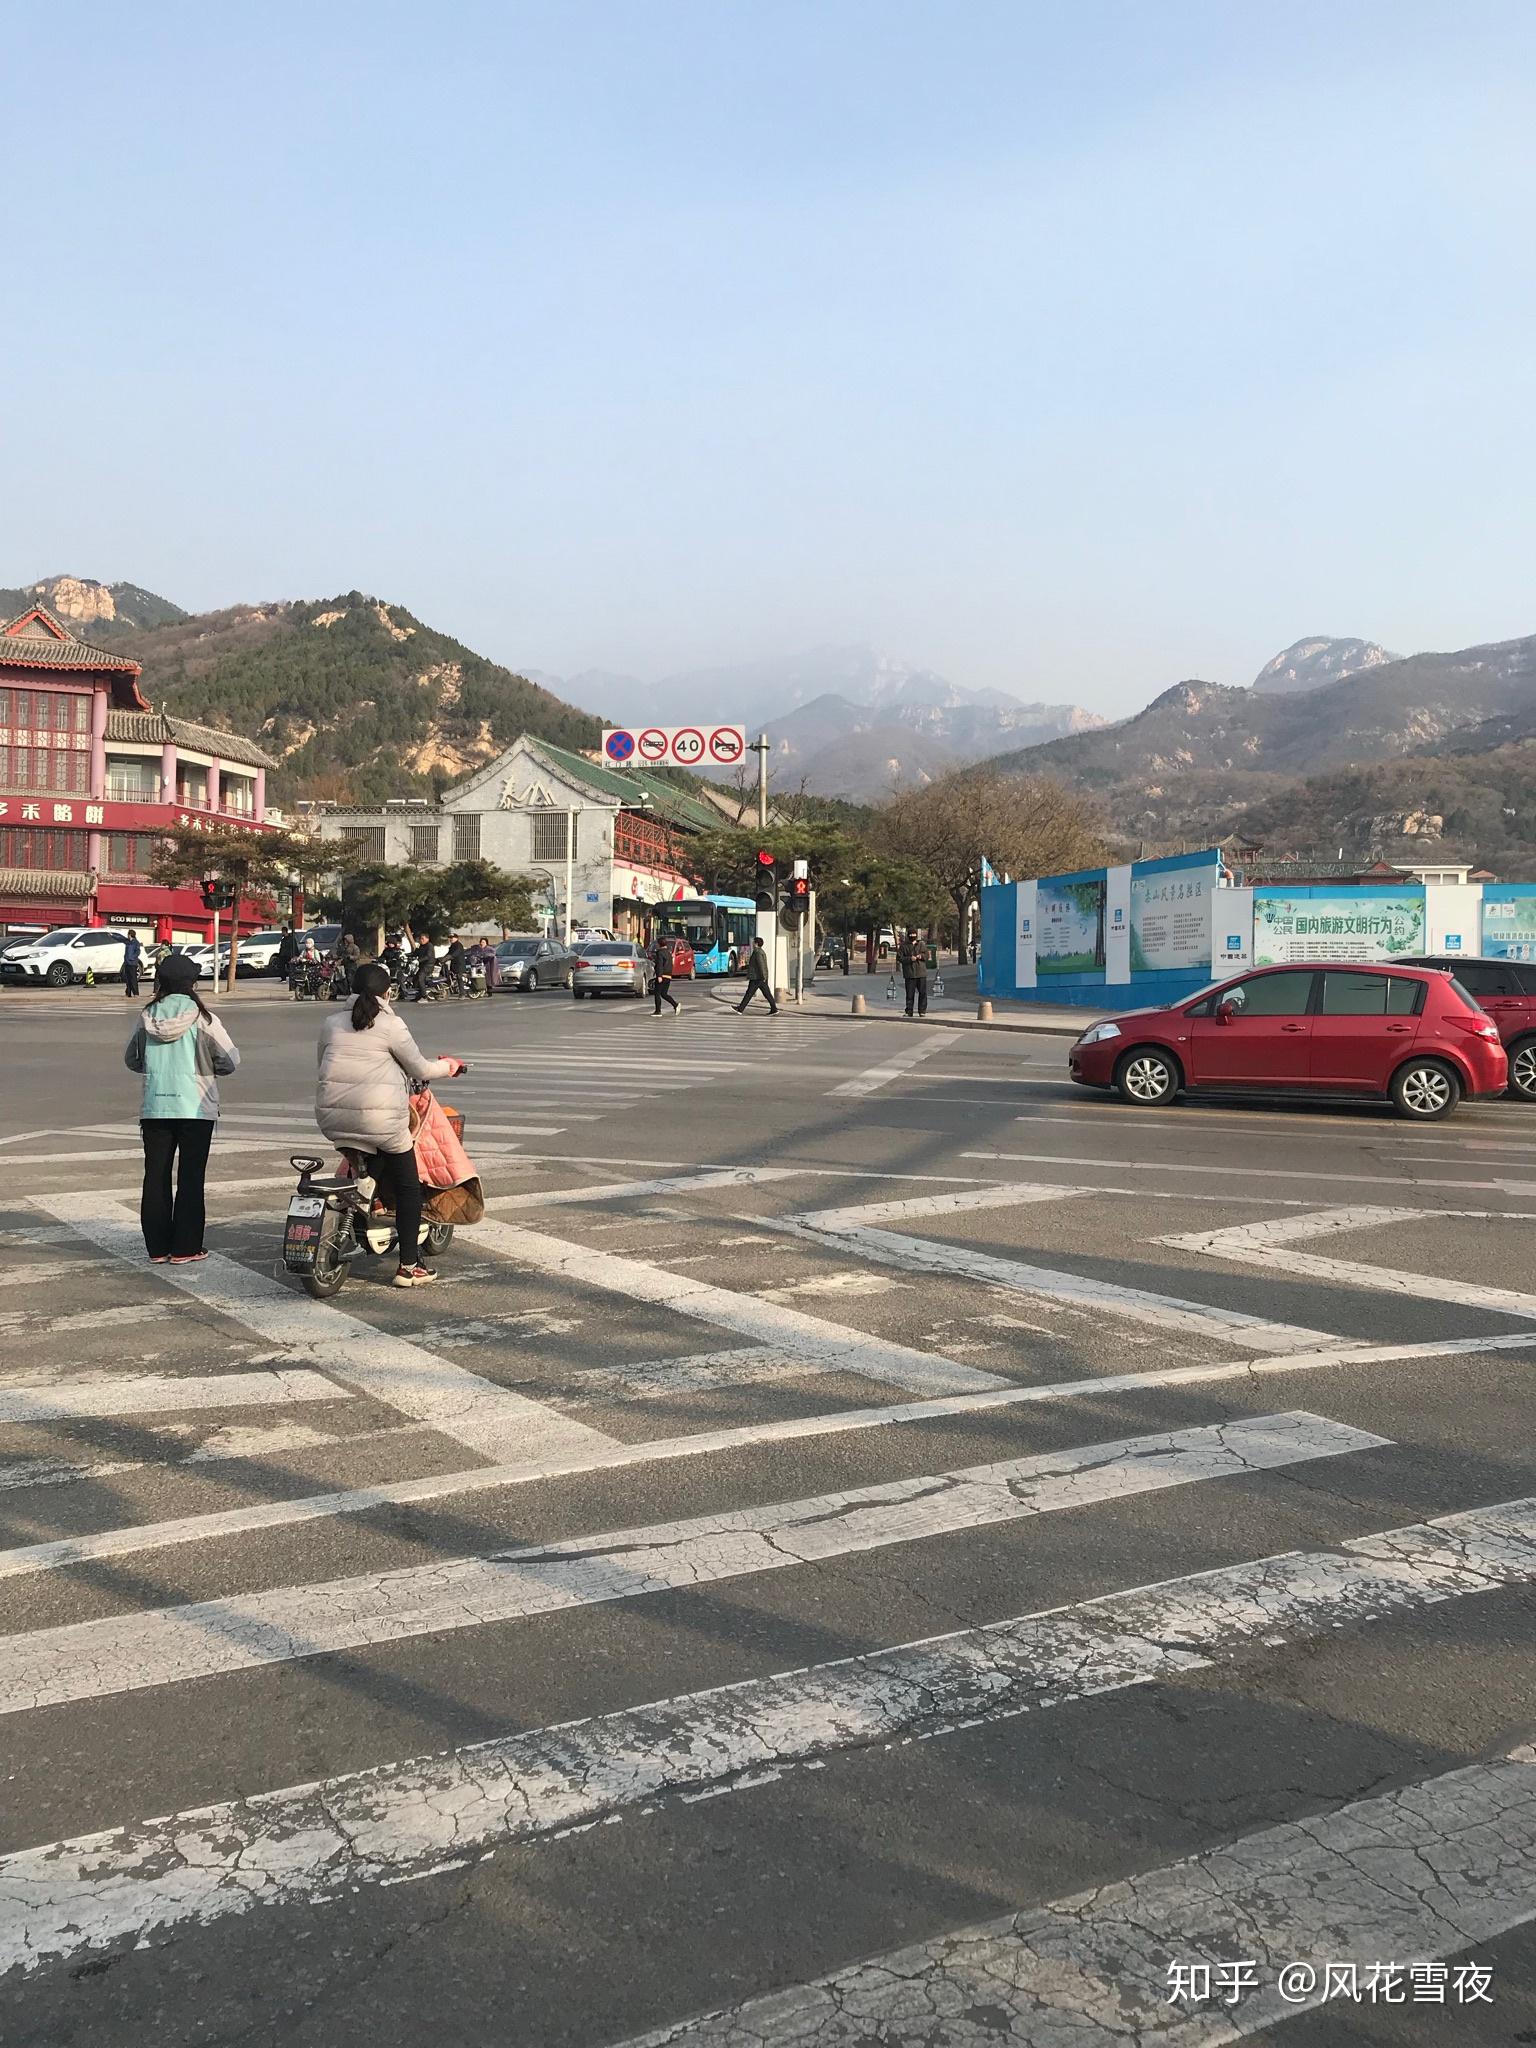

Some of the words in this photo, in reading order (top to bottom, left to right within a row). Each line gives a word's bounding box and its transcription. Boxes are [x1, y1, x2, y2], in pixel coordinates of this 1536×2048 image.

[677, 739, 699, 752] 40
[1273, 916, 1294, 925] 中国
[1296, 916, 1392, 935] 国内旅游文明行为
[1273, 925, 1293, 935] 公民
